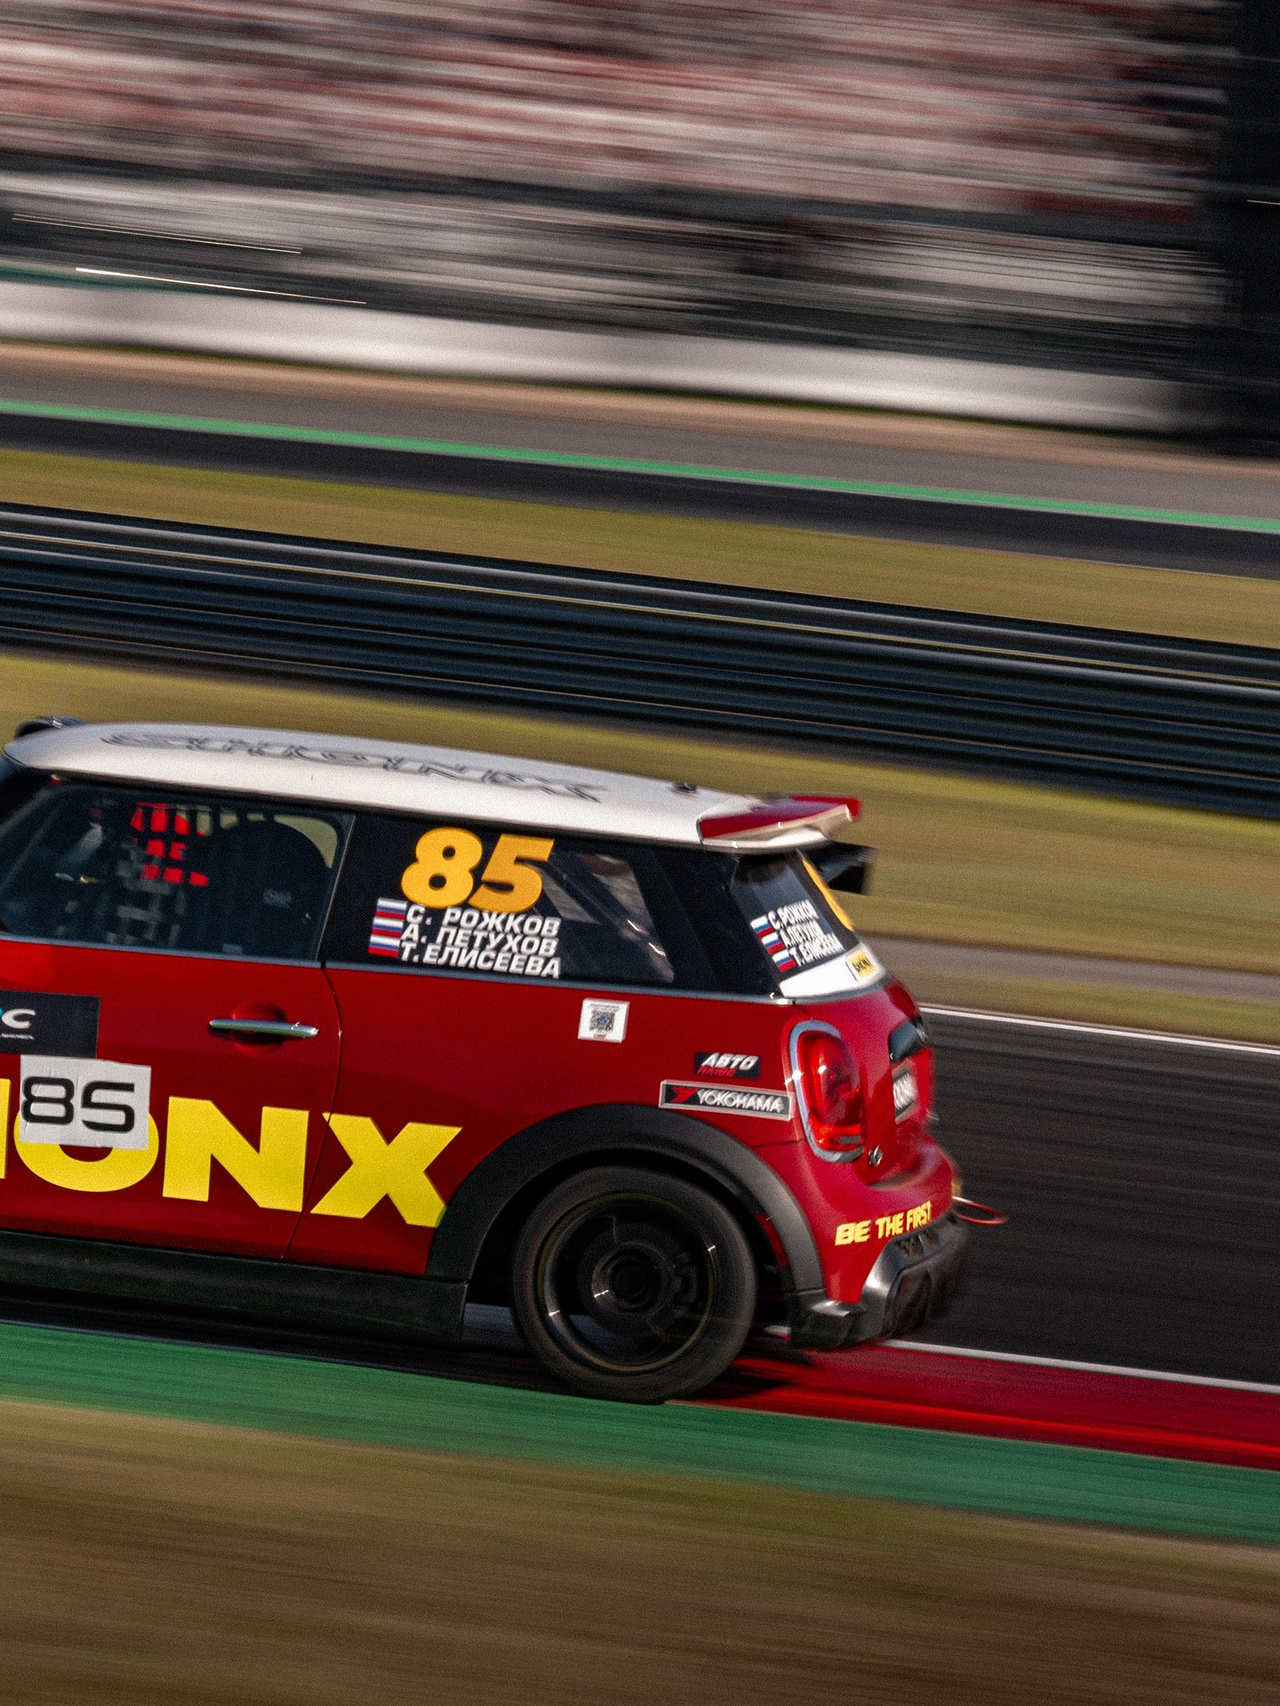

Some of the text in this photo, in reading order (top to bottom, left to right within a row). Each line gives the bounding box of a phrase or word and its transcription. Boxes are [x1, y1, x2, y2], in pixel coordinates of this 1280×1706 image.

[401, 827, 555, 914] 85
[442, 906, 562, 938] РОЖКОВ
[435, 926, 560, 958] ПЕТУХОВ
[701, 1052, 759, 1071] АВТО
[21, 1075, 136, 1134] 85
[697, 1088, 785, 1114] YOKOHAMA
[834, 1200, 932, 1246] BE THE FIRST
